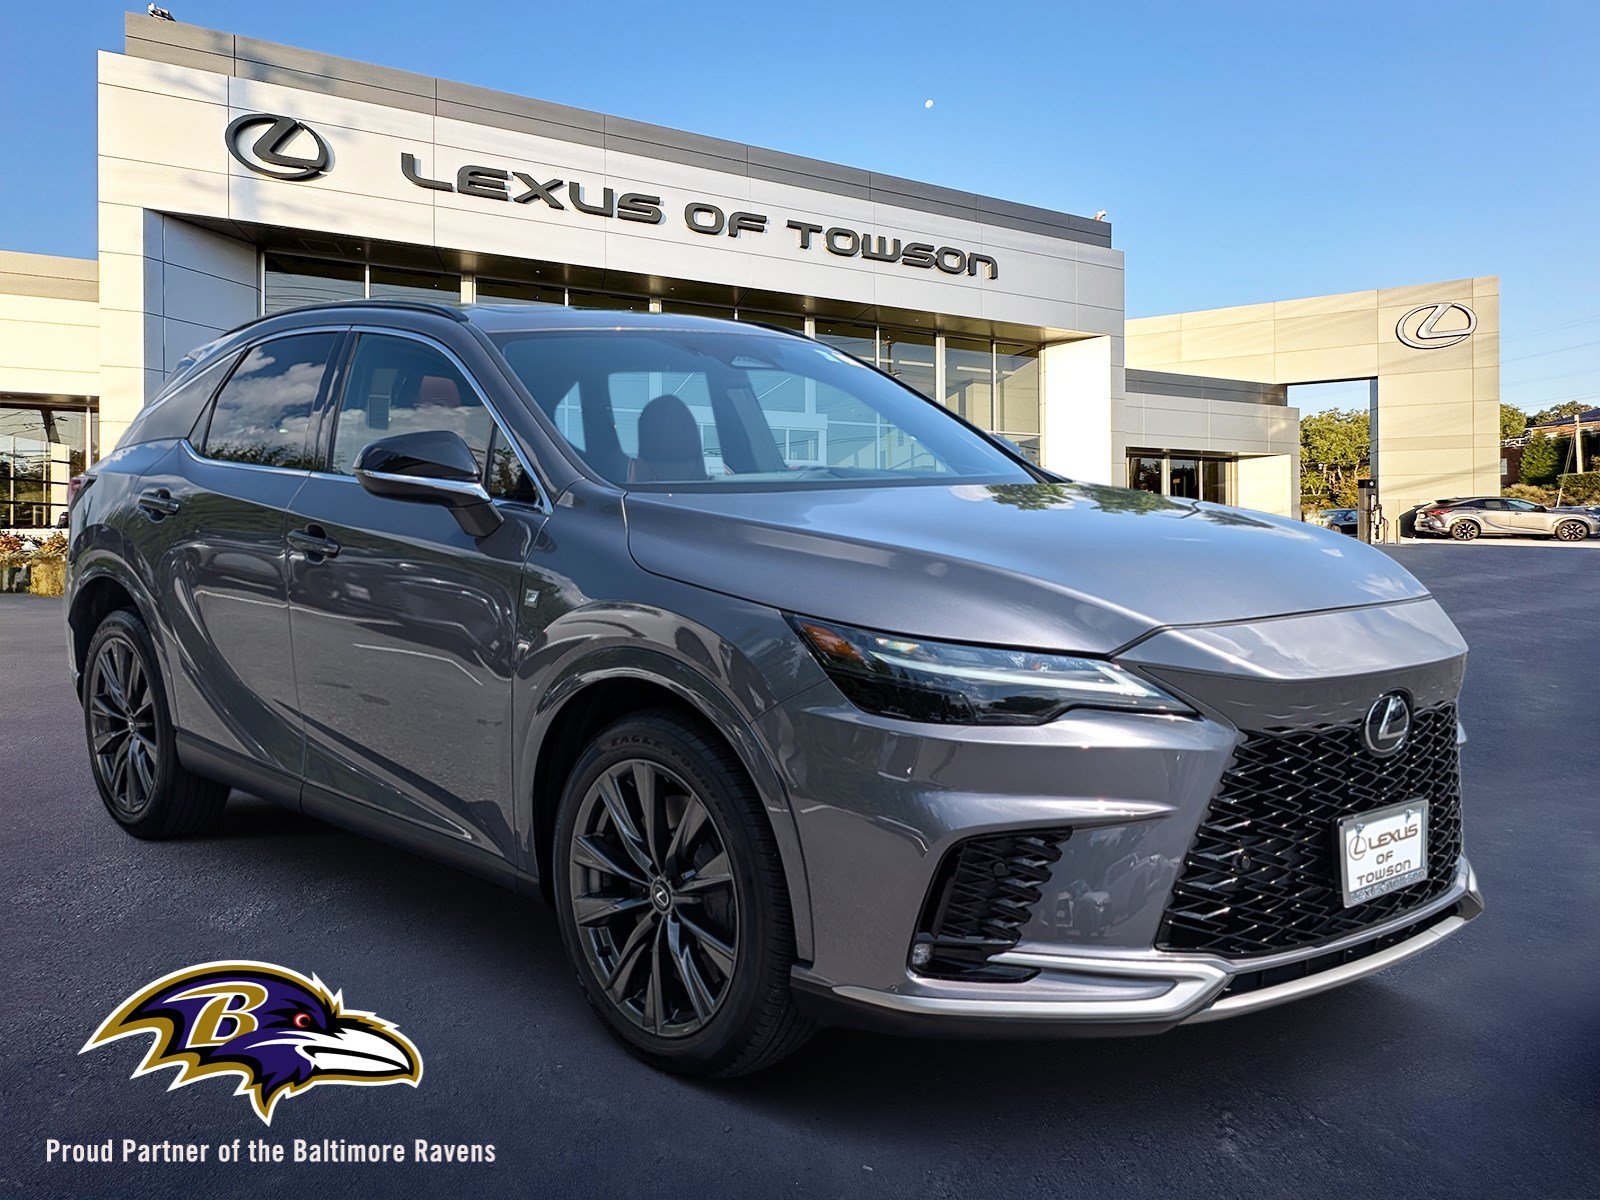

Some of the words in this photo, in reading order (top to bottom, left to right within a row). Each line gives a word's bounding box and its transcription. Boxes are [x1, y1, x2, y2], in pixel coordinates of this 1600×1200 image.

[401, 153, 663, 225] LEXUS
[685, 202, 768, 238] OF
[786, 219, 999, 281] TOWSON
[1368, 823, 1418, 850] LEXUS
[1376, 850, 1394, 865] OF
[1356, 859, 1411, 886] TOWSON
